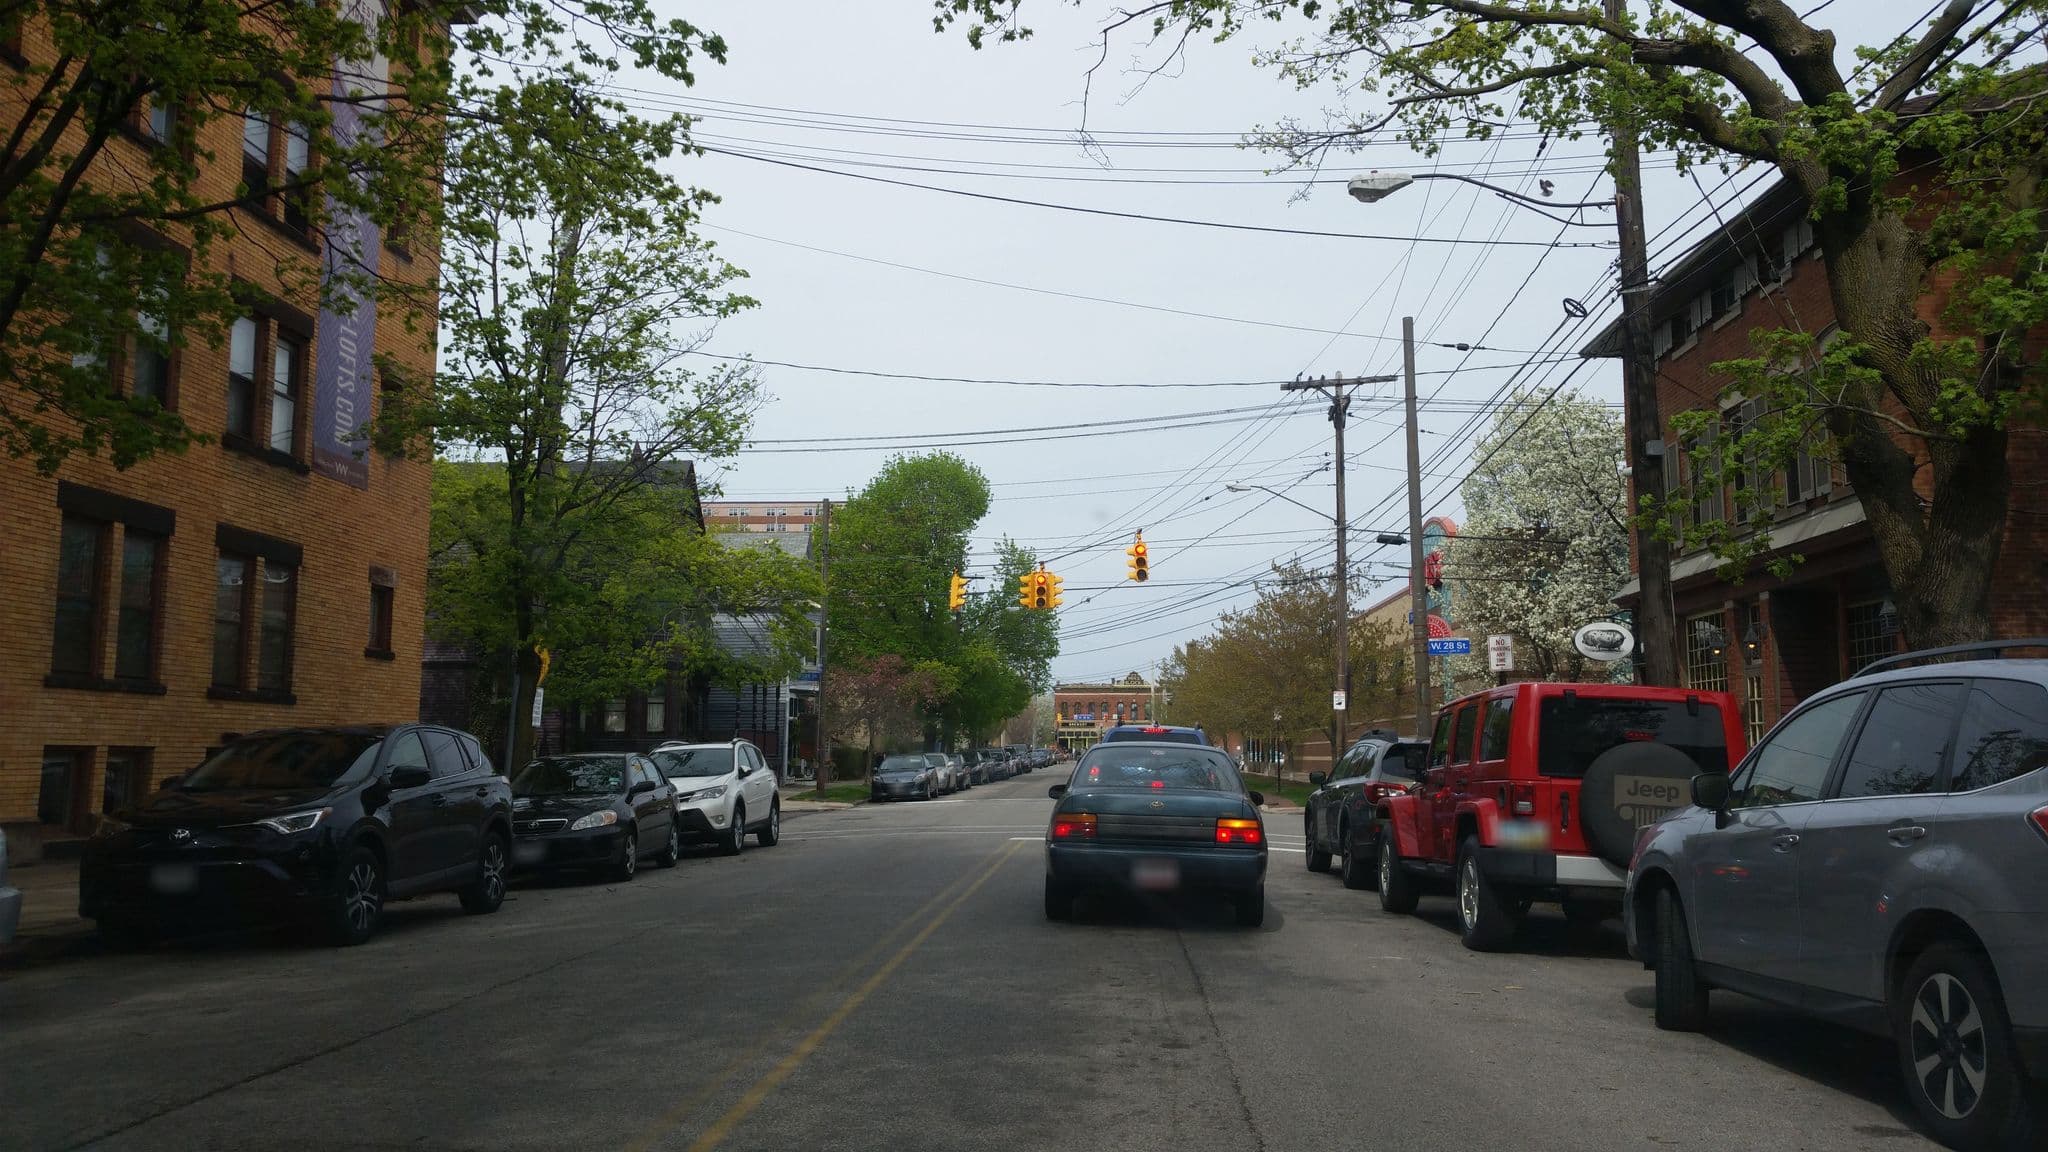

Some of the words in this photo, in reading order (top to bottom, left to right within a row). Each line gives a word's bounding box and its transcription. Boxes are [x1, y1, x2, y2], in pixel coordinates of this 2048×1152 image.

[1431, 642, 1442, 650] W.
[1443, 642, 1454, 650] 28
[1627, 780, 1680, 802] Jeep
